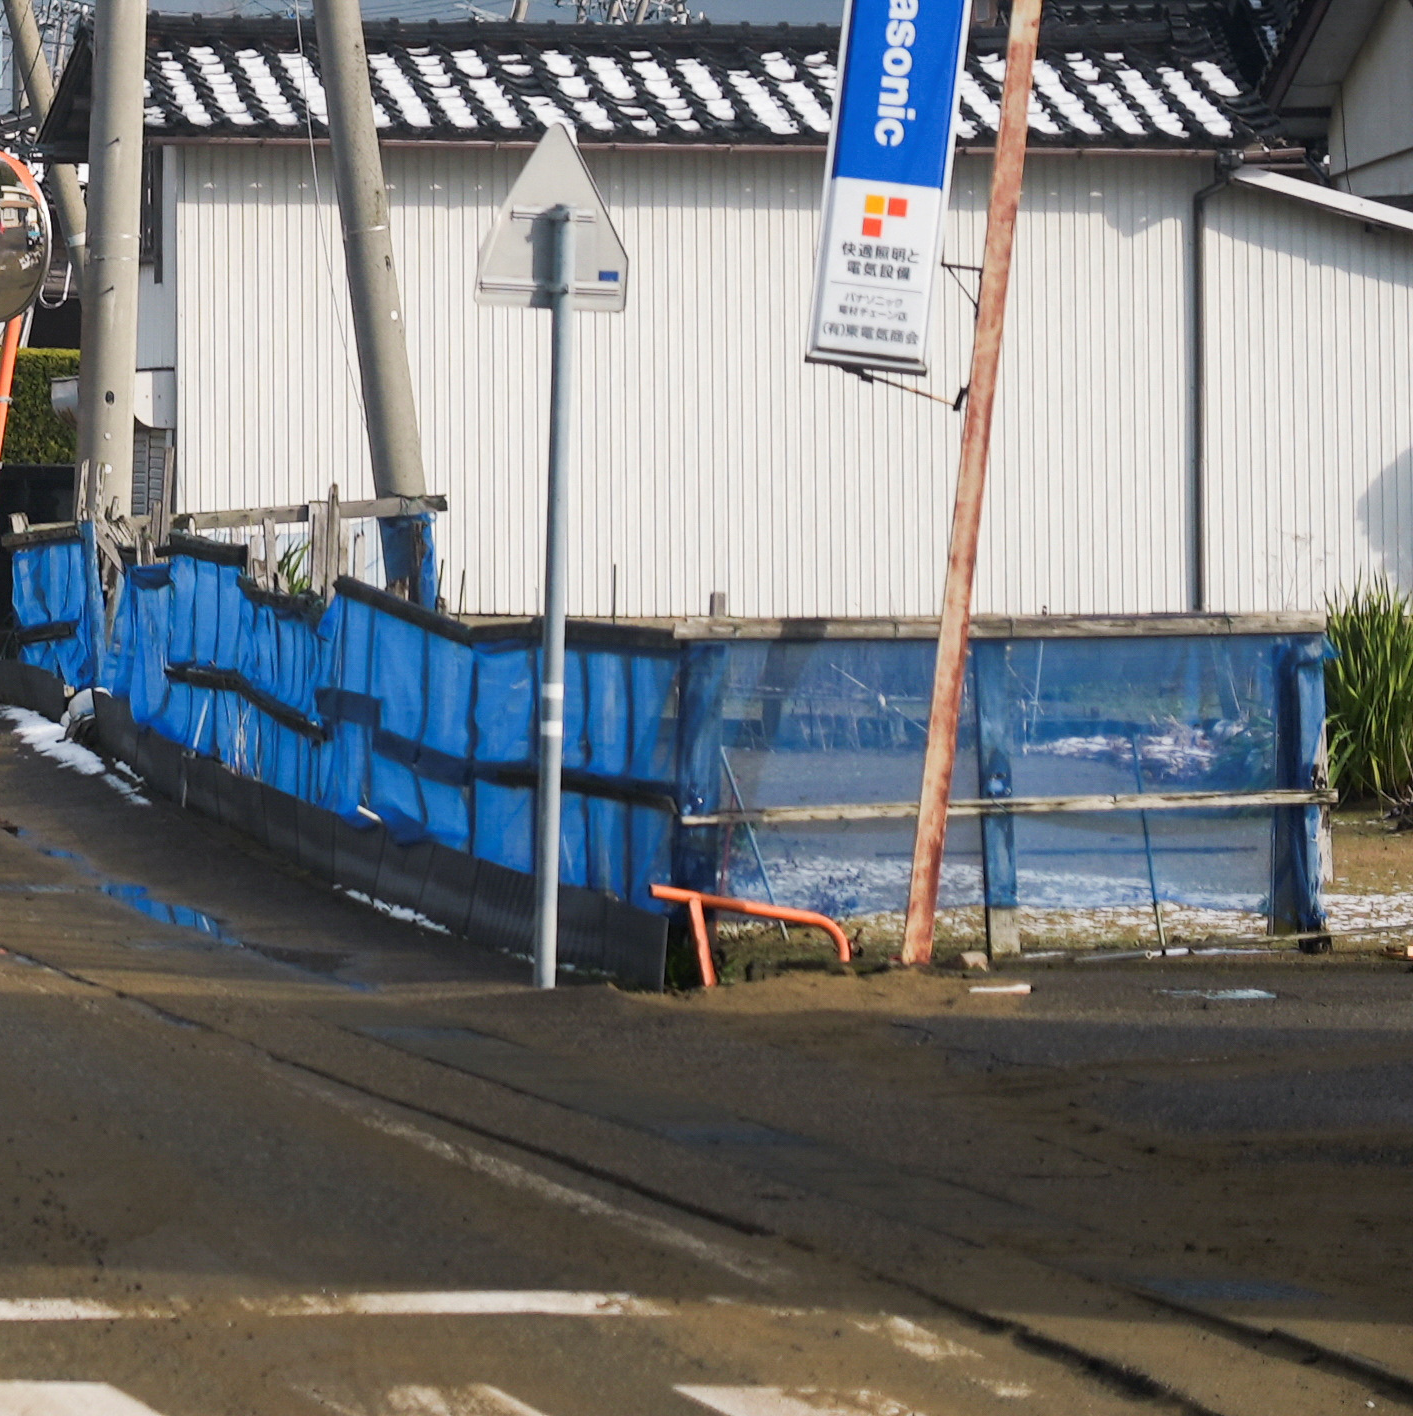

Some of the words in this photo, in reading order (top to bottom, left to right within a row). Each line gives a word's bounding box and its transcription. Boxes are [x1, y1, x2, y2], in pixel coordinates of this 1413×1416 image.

[842, 241, 920, 264] 快適照明と
[847, 260, 910, 280] 電気設備
